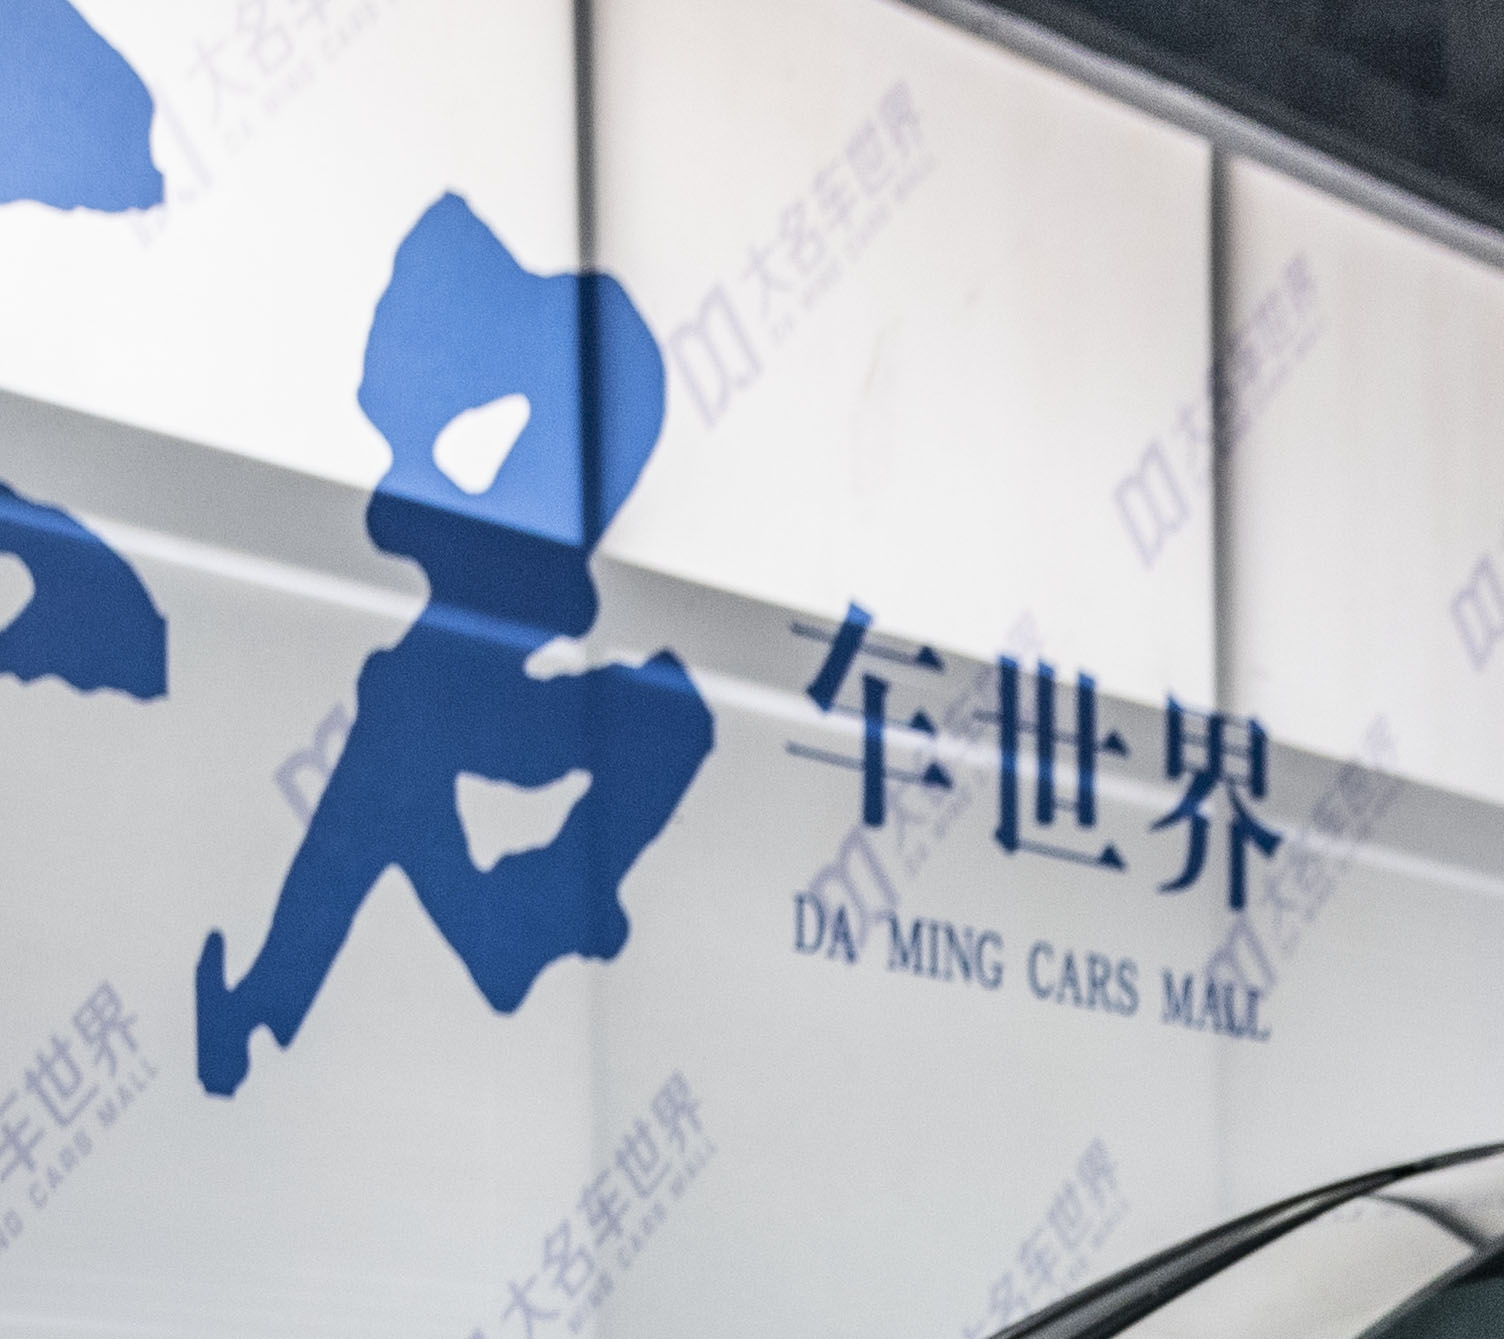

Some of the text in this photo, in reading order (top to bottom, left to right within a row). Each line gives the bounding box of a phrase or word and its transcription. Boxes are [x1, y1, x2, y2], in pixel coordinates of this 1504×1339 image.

[786, 599, 1284, 910] 车世界
[794, 892, 1273, 1043] DA MING CARS MALL
[95, 1056, 160, 1130] MALL
